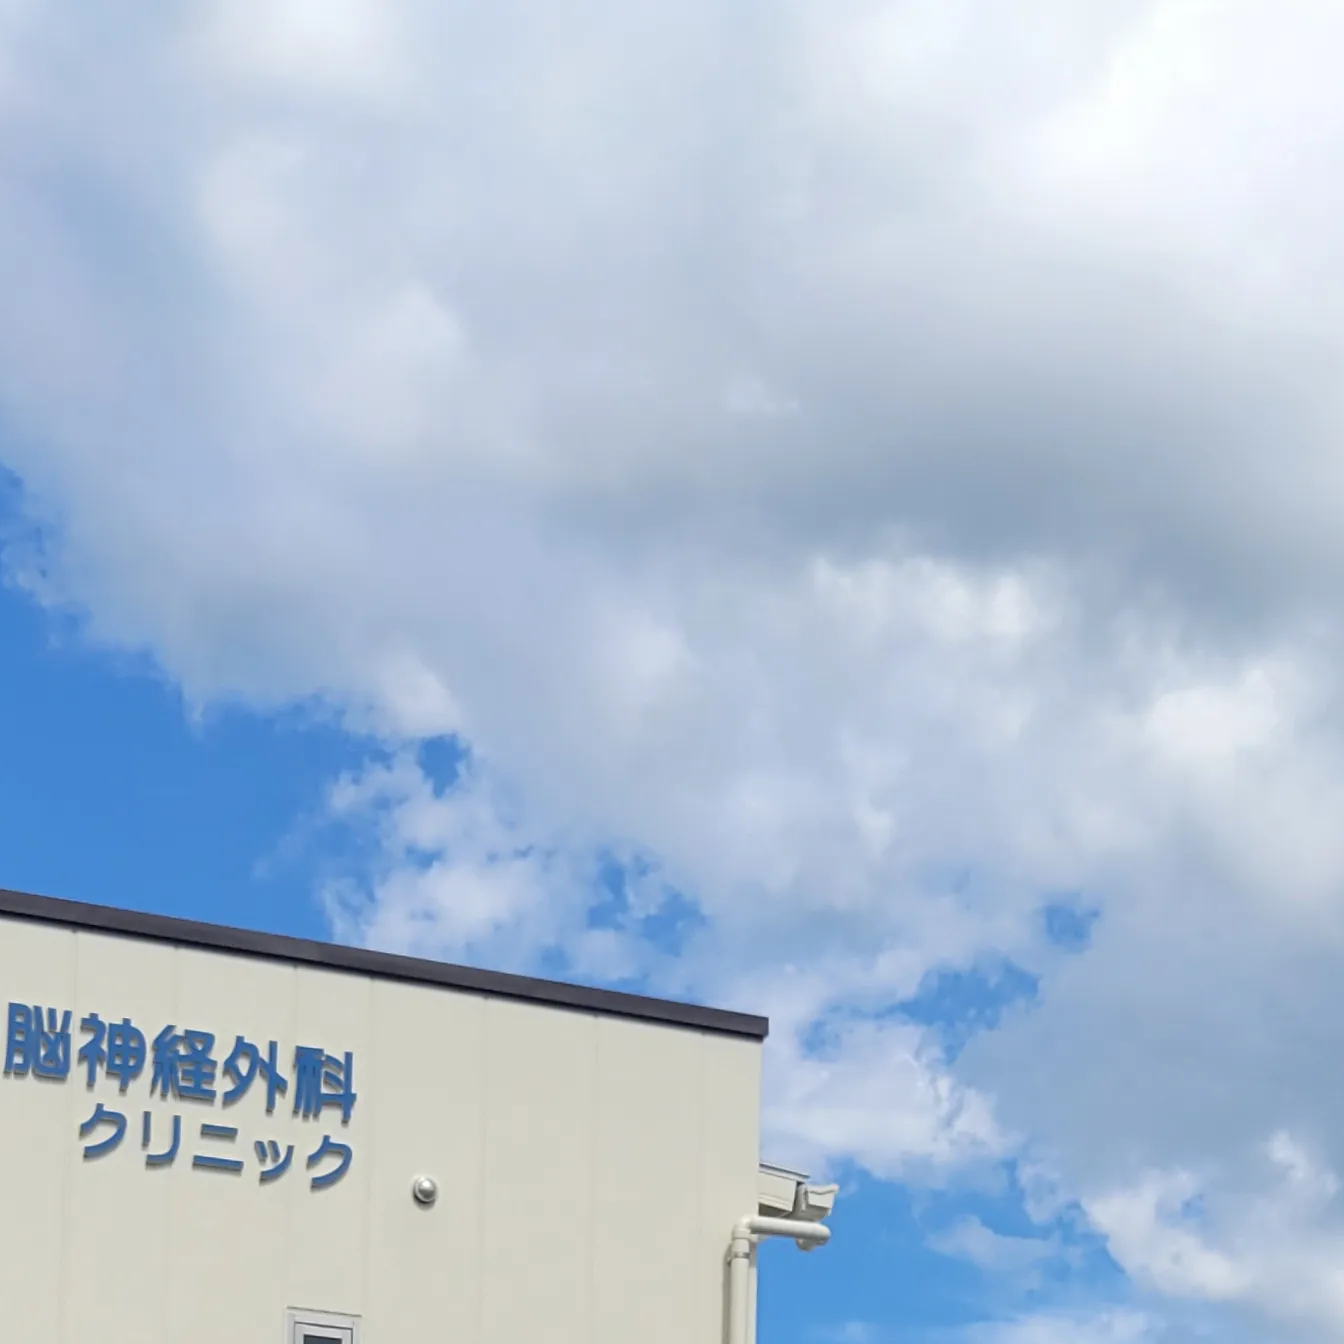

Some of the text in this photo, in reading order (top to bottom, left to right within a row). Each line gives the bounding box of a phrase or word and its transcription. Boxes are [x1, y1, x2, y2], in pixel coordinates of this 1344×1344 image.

[79, 1102, 354, 1188] クリニック
